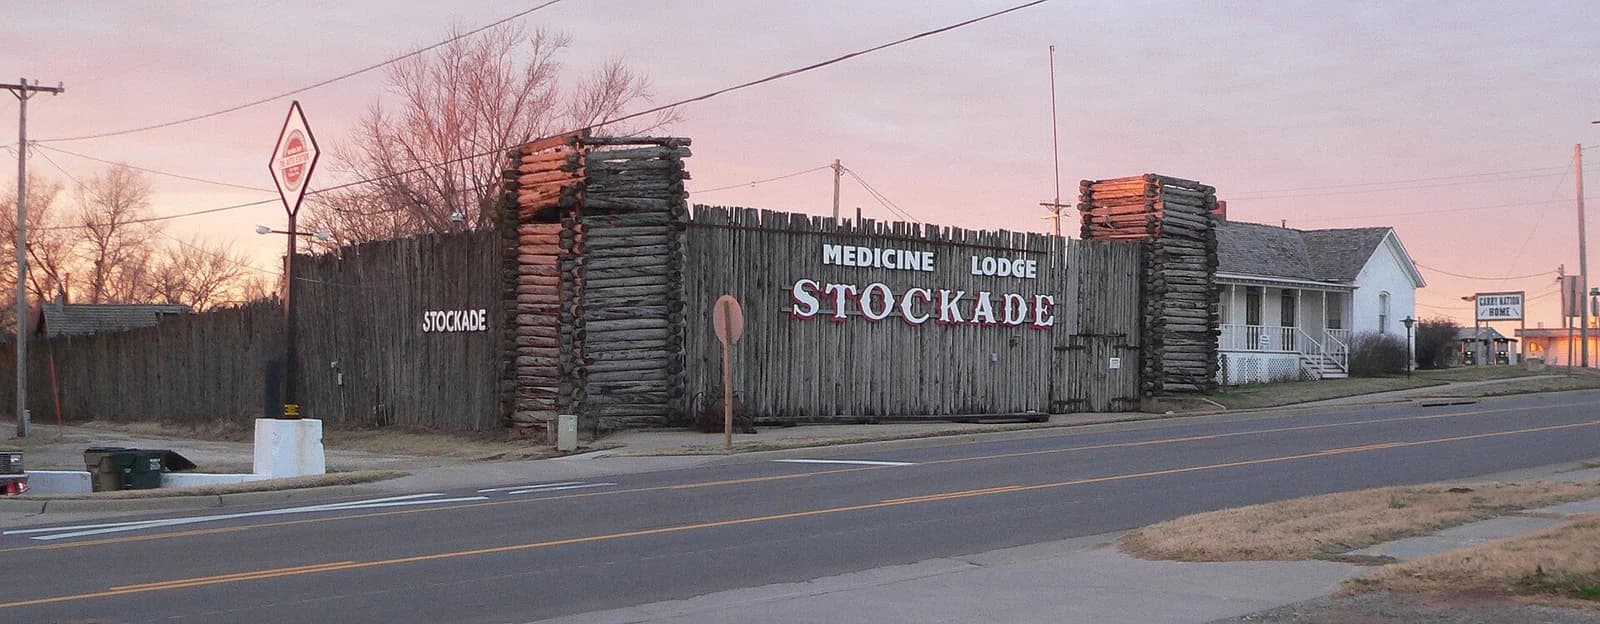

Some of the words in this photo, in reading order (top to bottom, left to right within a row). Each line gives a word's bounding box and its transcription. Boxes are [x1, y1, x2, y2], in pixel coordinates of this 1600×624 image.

[822, 244, 935, 272] MEDICINE
[971, 255, 1037, 279] LODGE
[791, 279, 1056, 329] STOCKADE
[1489, 307, 1511, 317] HOME
[422, 309, 487, 332] STOCKADE
